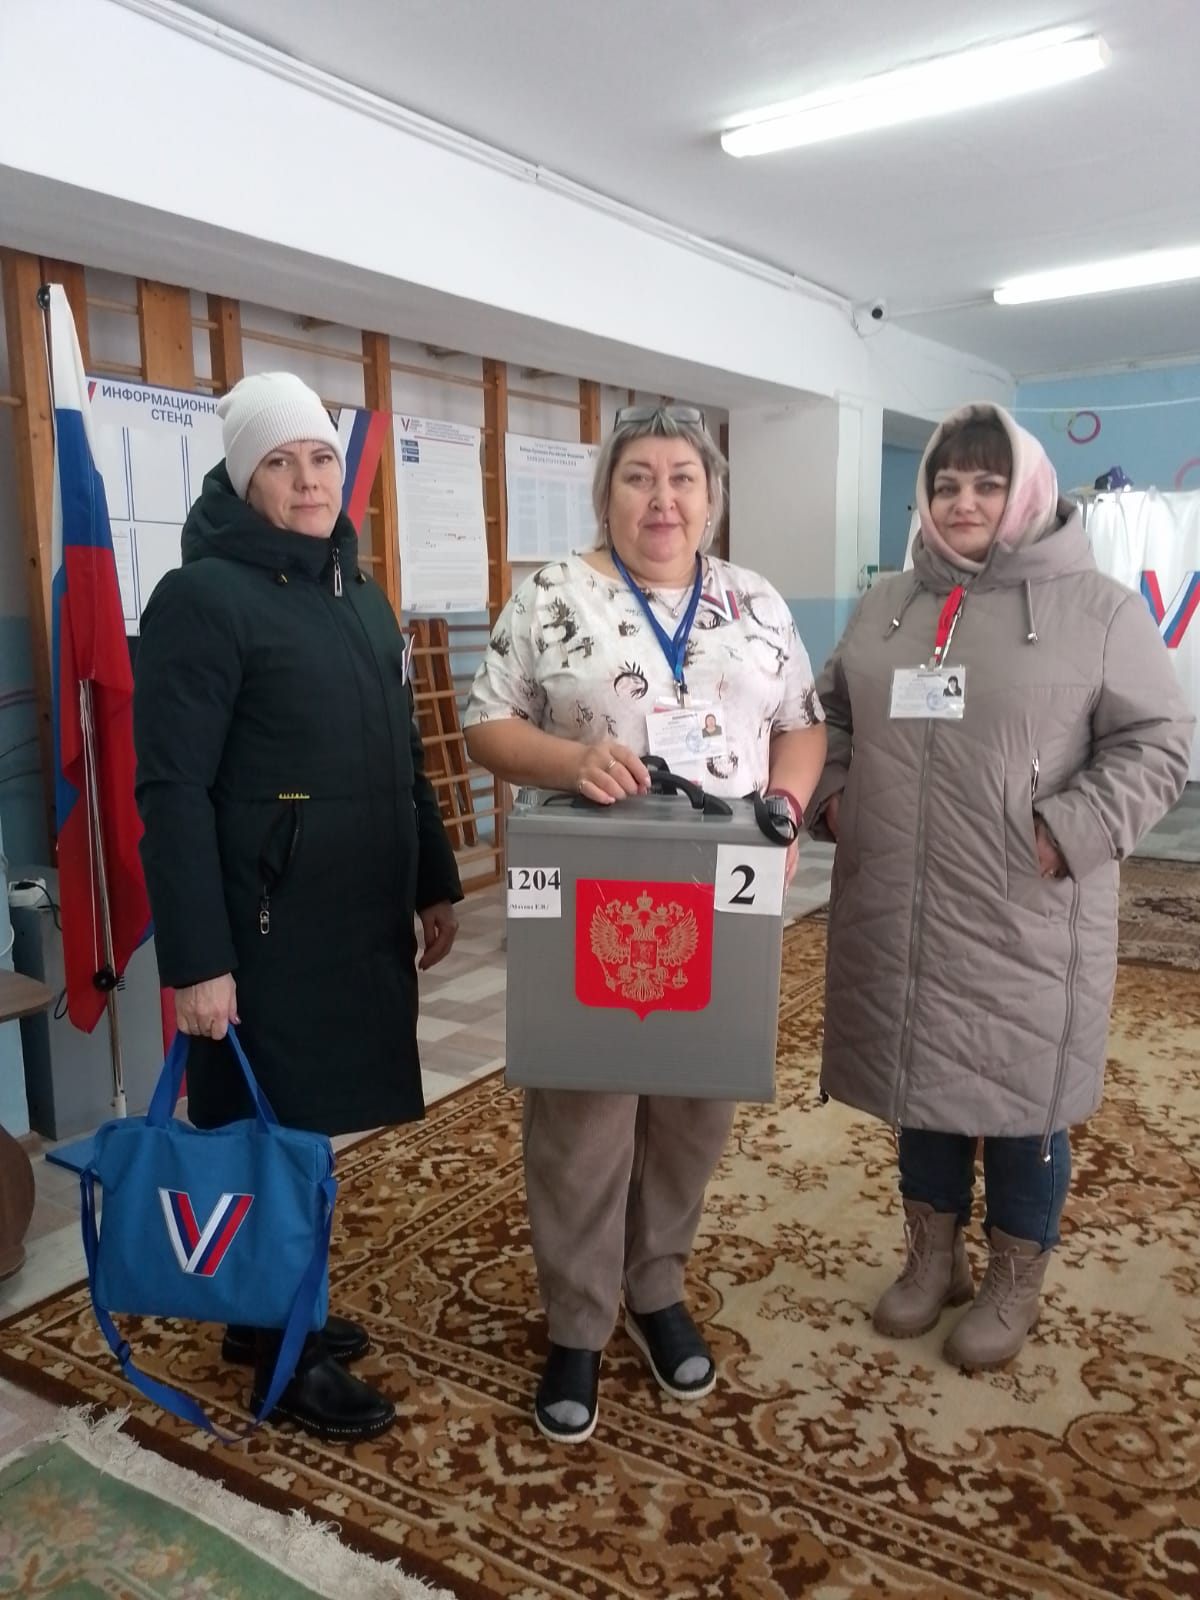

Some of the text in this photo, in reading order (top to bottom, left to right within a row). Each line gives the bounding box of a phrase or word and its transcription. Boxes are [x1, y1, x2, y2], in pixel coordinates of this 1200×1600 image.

[102, 385, 218, 415] ИНФОРМАЦИОНН
[151, 408, 193, 428] СТЕНД
[507, 869, 561, 890] 1204
[728, 864, 756, 906] 2
